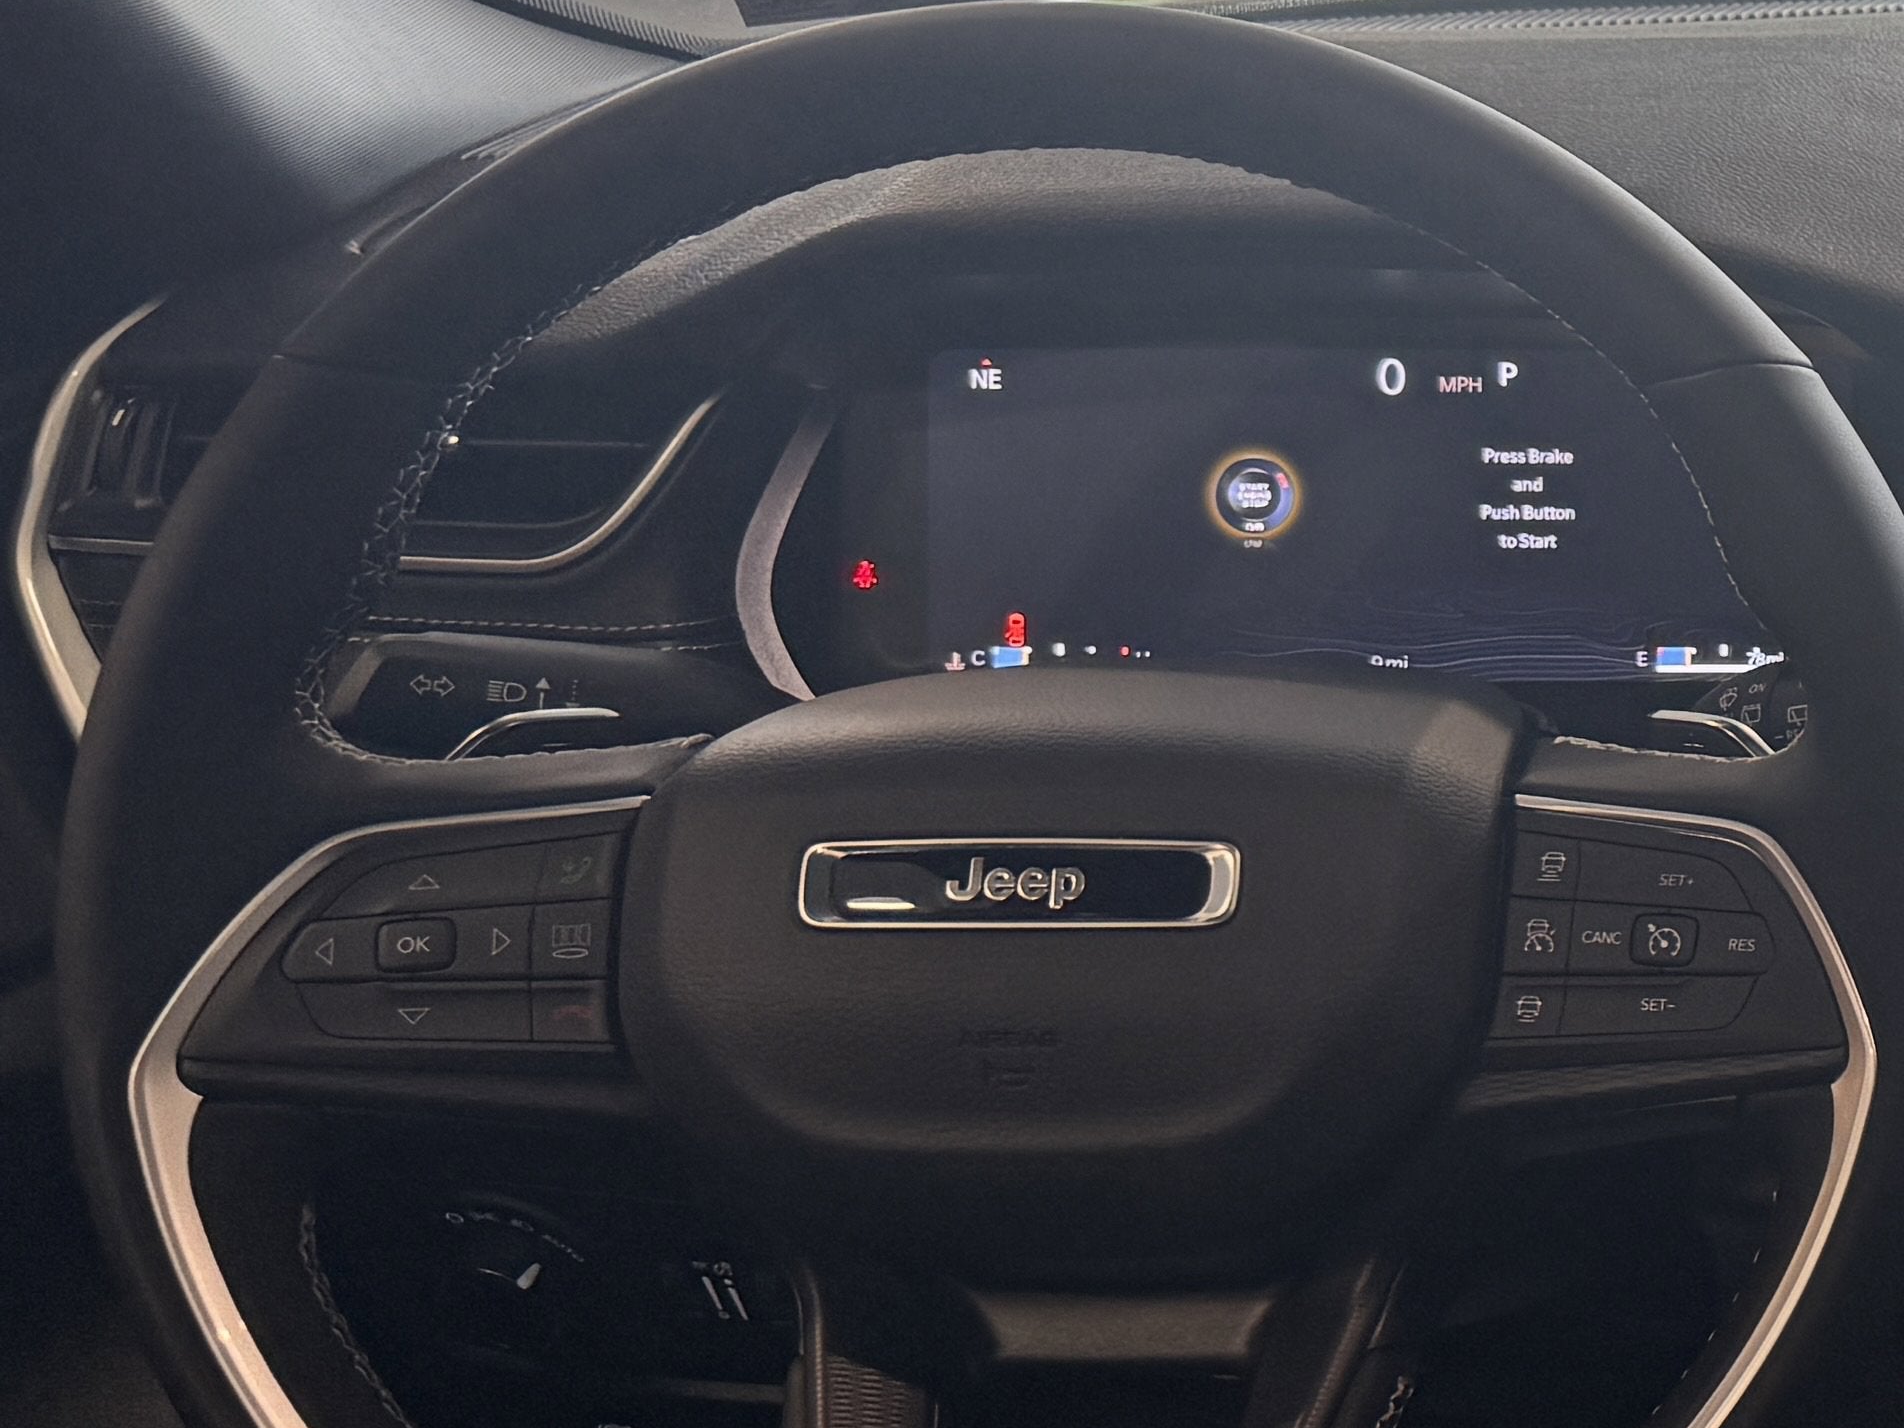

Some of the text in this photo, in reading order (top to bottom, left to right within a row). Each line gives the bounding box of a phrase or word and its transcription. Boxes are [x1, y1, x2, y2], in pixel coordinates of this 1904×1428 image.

[968, 368, 1003, 390] NE
[1375, 357, 1518, 396] 0 MPH P
[1480, 447, 1574, 465] Press Brake
[1510, 476, 1544, 493] and
[1479, 504, 1576, 521] Push Button
[1497, 533, 1558, 549] to Start
[971, 650, 985, 667] C
[1635, 651, 1648, 668] E
[945, 856, 1086, 910] Jeep
[396, 935, 431, 954] OK
[1582, 930, 1622, 945] CANC
[1728, 938, 1757, 952] RES
